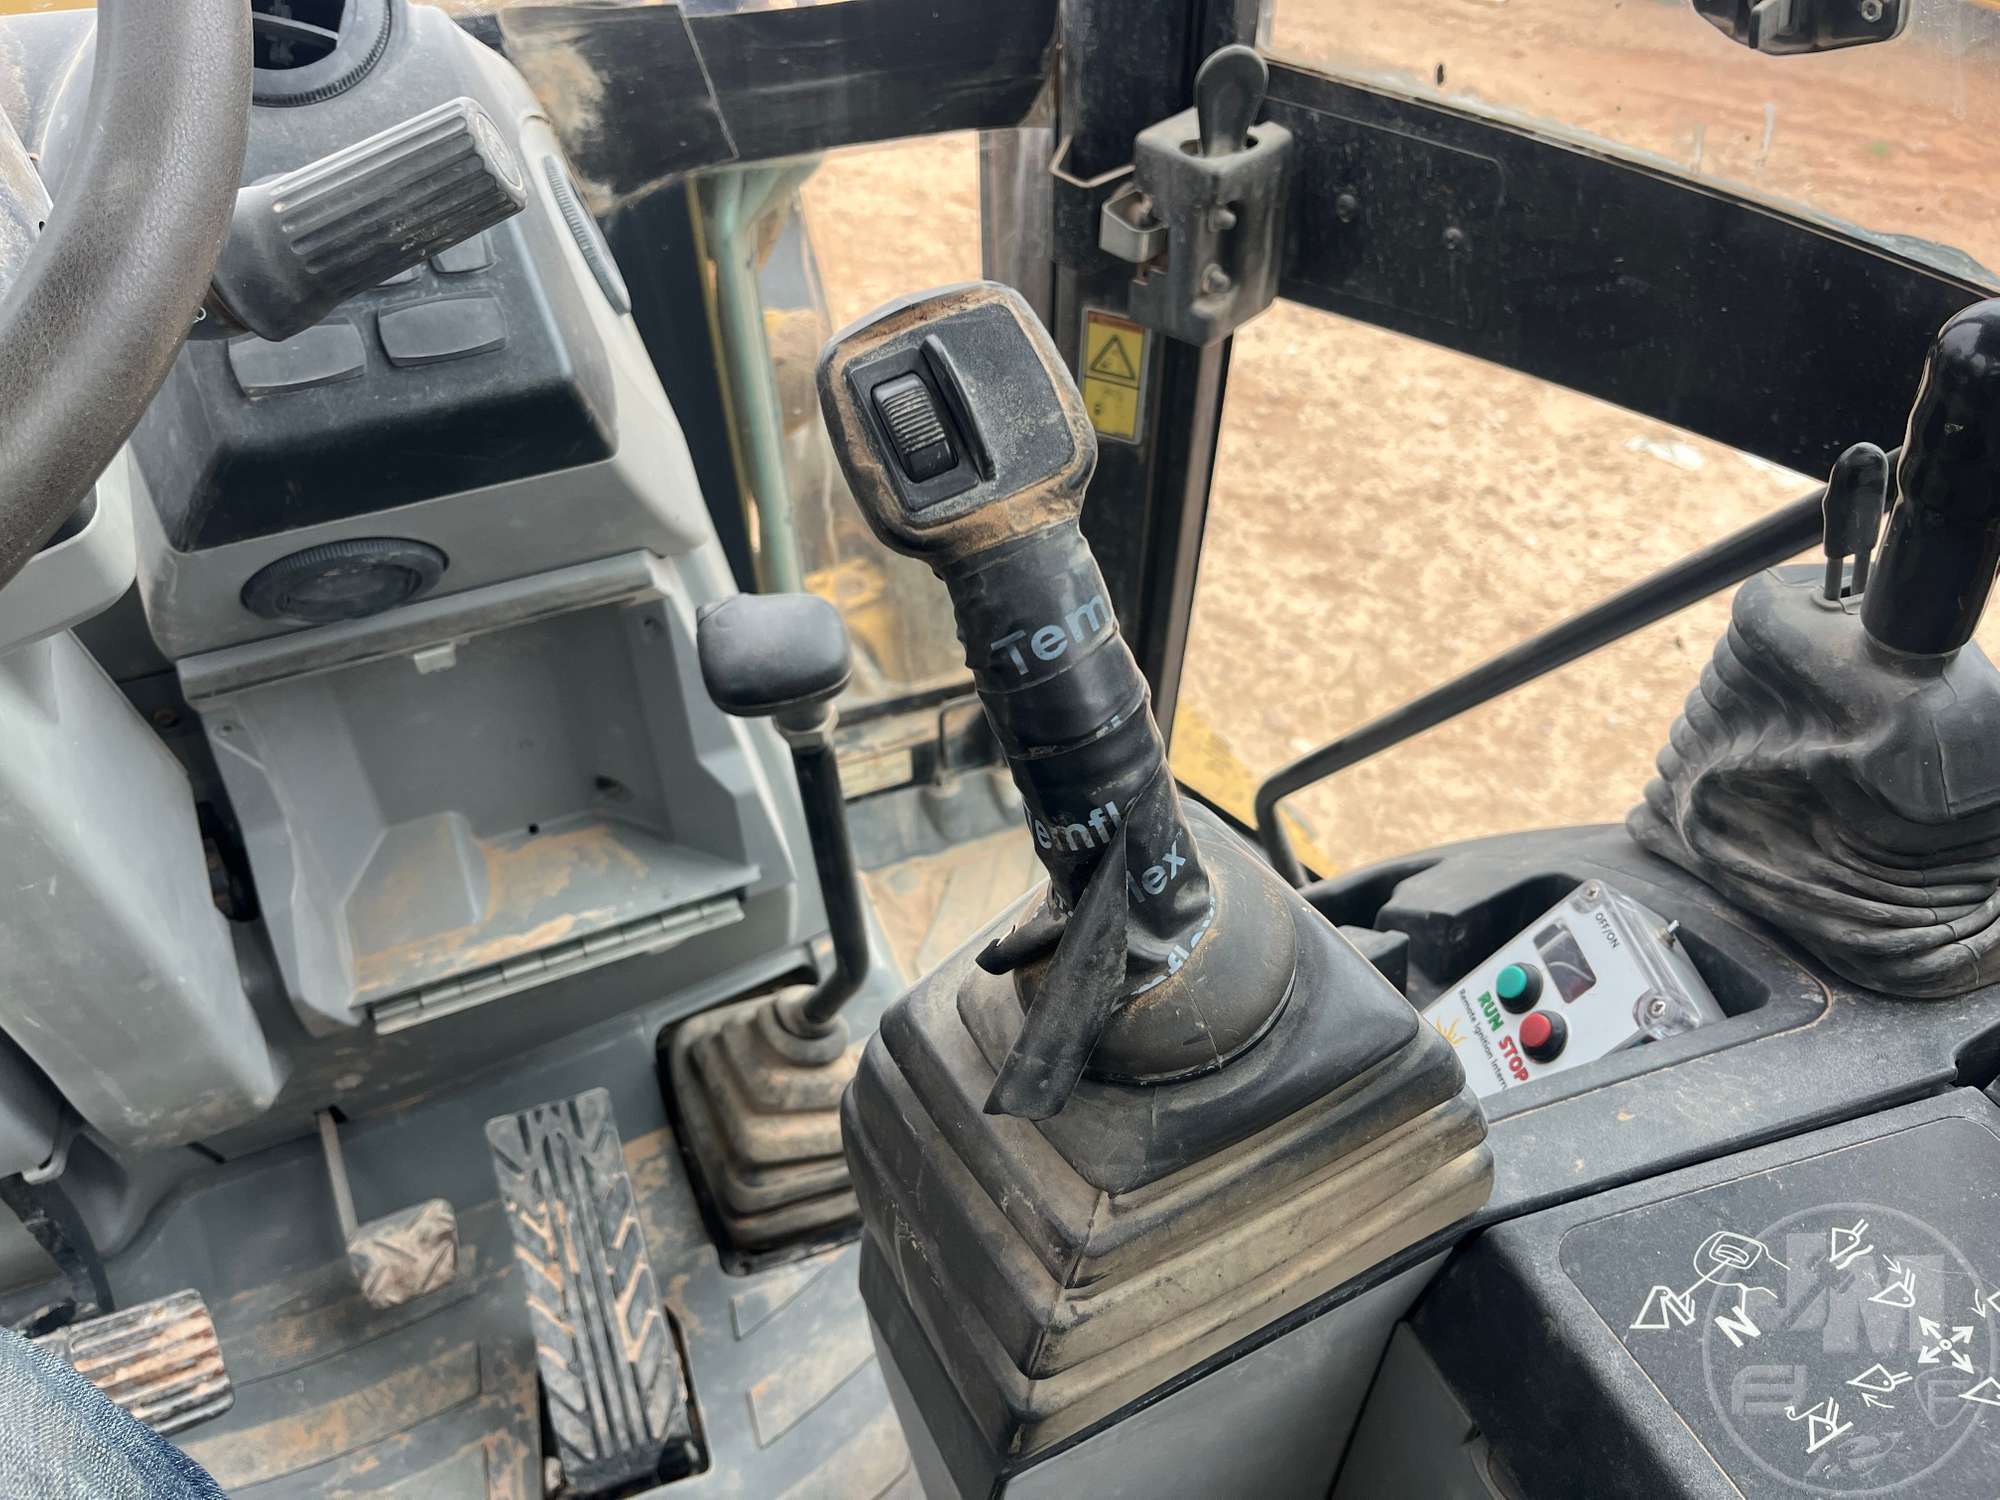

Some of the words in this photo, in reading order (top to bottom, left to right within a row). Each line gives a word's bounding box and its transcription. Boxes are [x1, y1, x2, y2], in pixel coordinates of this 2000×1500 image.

[990, 594, 1111, 676] Tem
[1595, 912, 1620, 948] OFF/ON
[1459, 988, 1477, 1022] Remote
[1477, 991, 1504, 1032] RUN
[1498, 1035, 1529, 1081] STOP
